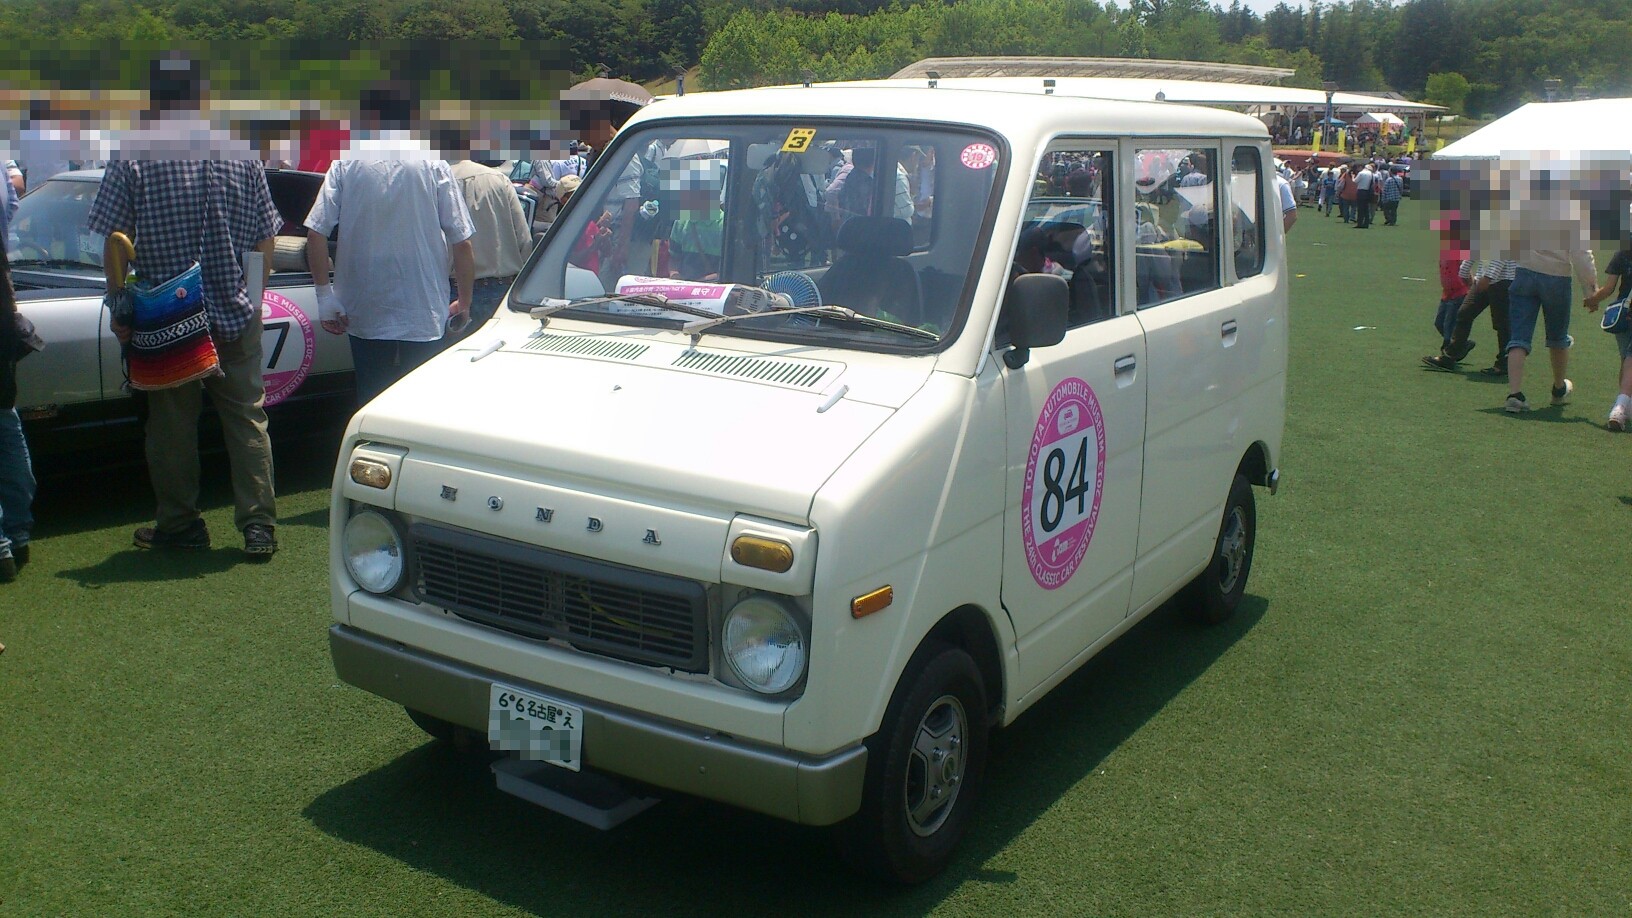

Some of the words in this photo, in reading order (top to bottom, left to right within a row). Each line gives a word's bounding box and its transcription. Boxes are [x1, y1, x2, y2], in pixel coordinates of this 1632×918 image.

[788, 136, 807, 148] 3
[263, 322, 290, 369] 7
[281, 299, 311, 334] MUSEUM
[264, 393, 281, 404] CAR
[282, 362, 310, 396] FESTIVAL
[305, 338, 313, 359] 2013
[1025, 423, 1045, 492] TOYOTA
[1043, 382, 1087, 422] AUTOMOBILE
[1088, 395, 1104, 453] MUSEUM
[440, 484, 662, 546] HONDA
[1040, 436, 1089, 532] 84
[1024, 505, 1032, 537] THE
[1035, 563, 1060, 586] CLASSIC
[1061, 561, 1074, 581] CAR
[1075, 503, 1099, 565] FESTIVAL
